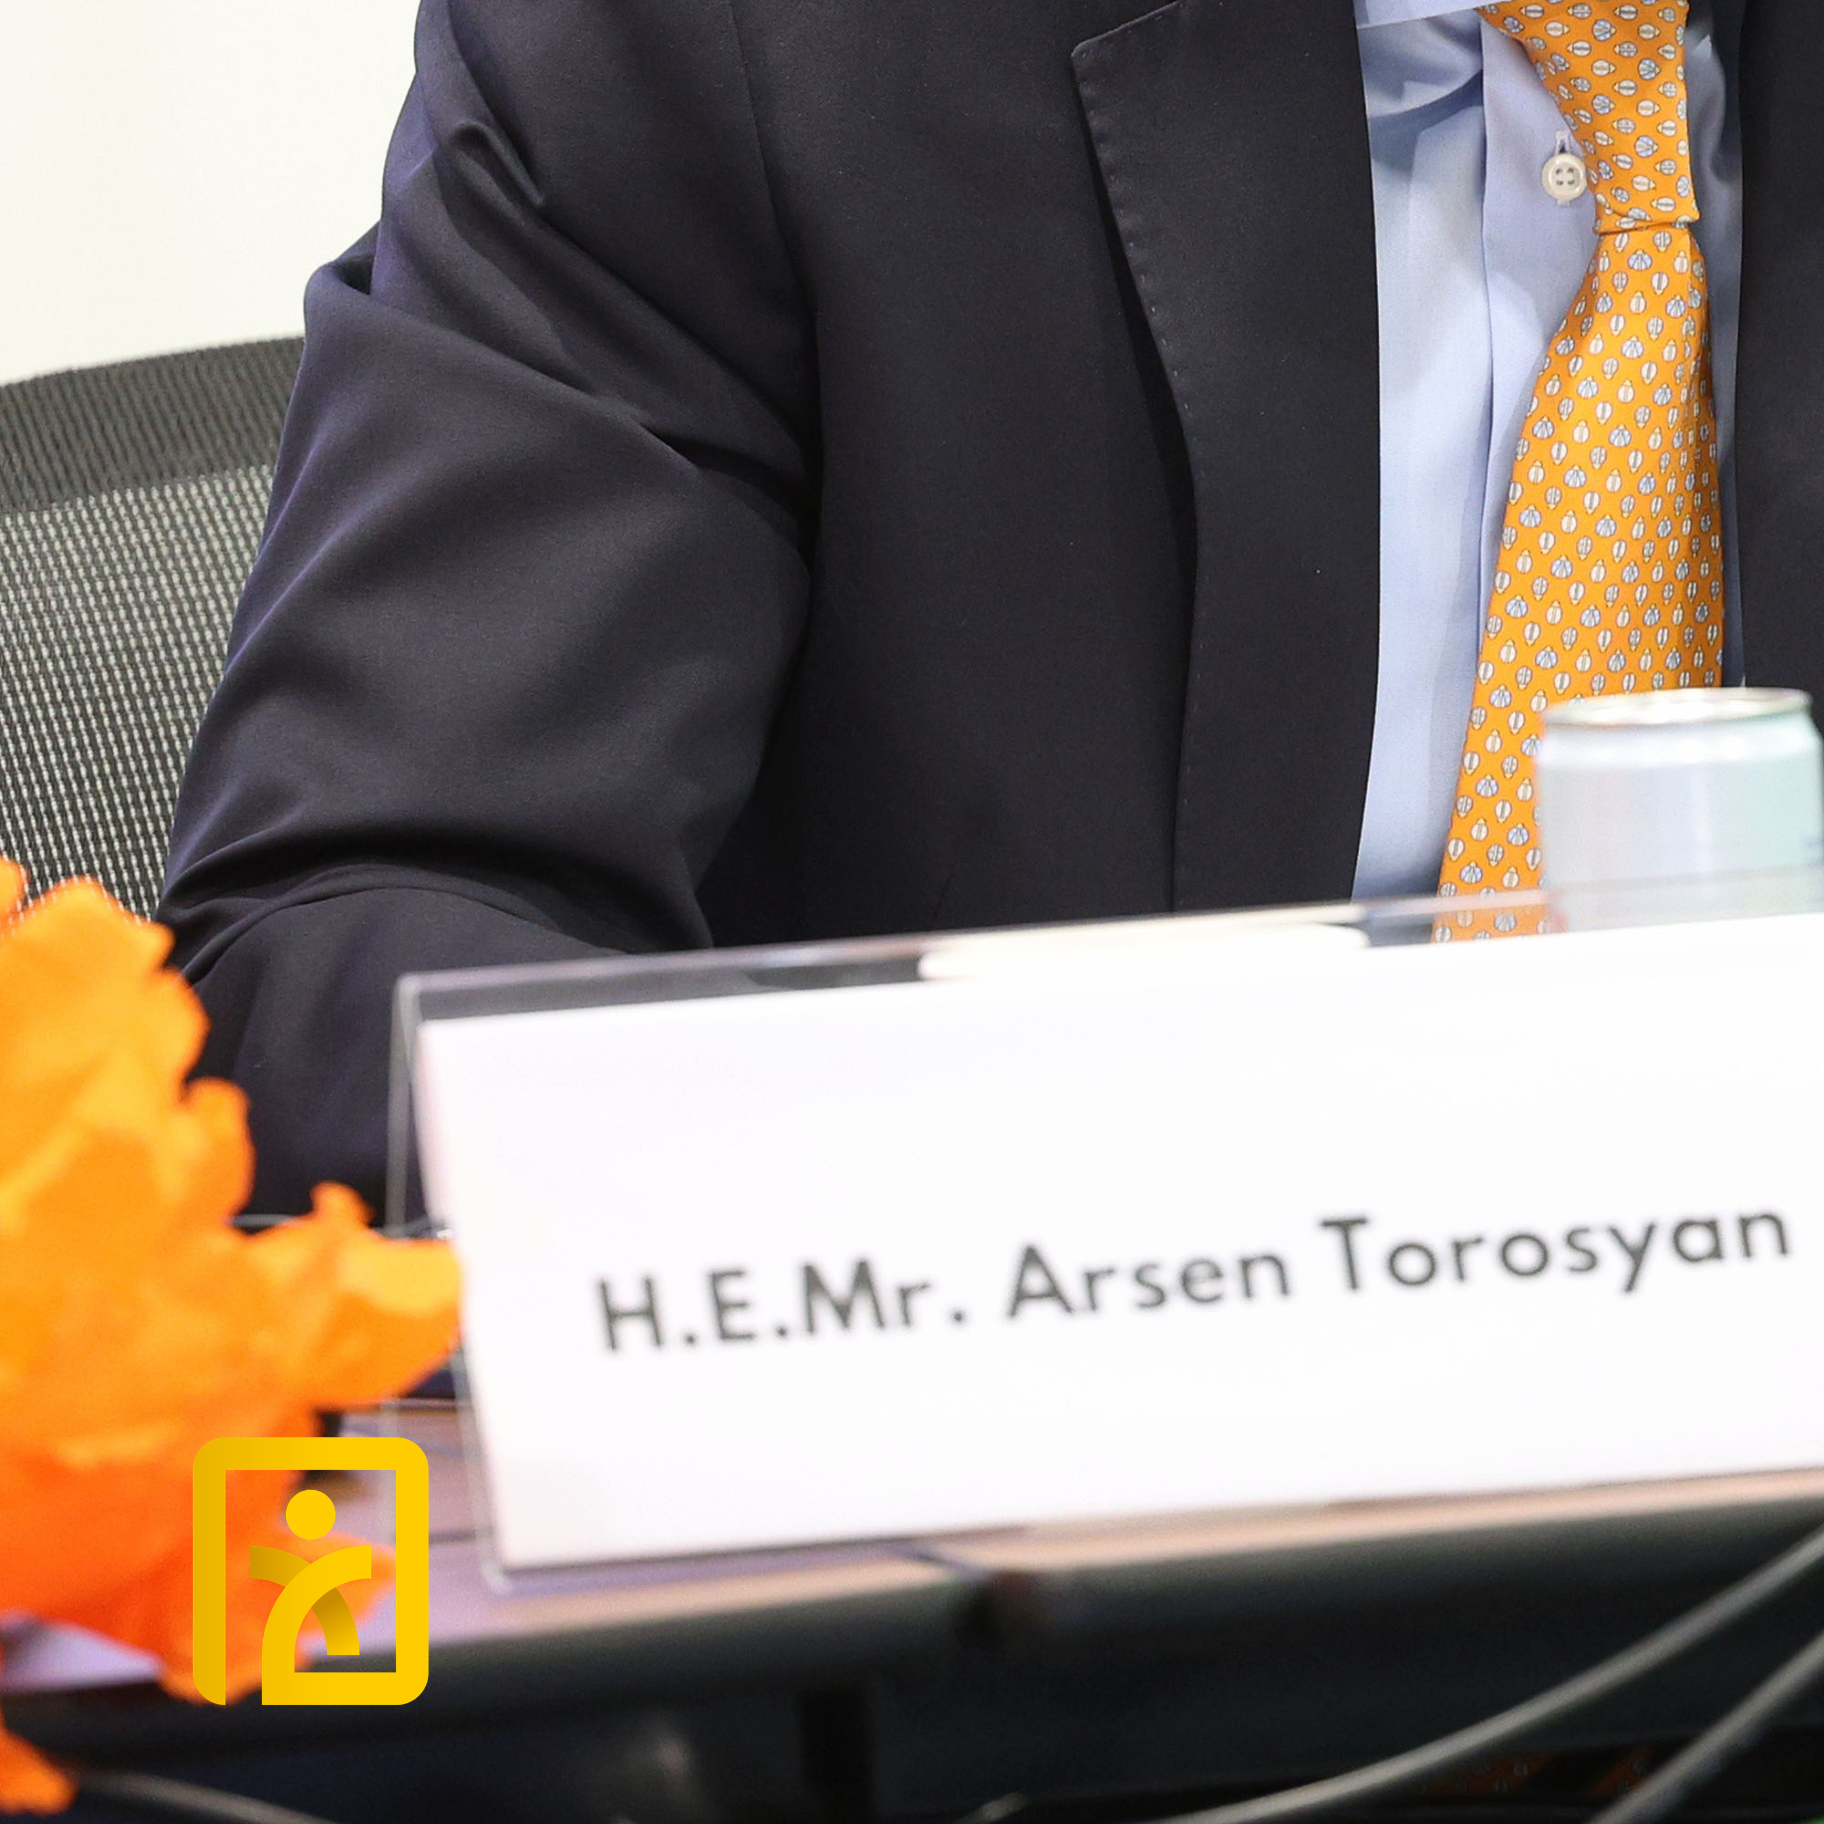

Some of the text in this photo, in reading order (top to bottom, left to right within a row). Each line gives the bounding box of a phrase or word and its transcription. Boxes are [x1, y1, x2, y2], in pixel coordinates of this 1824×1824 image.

[596, 1210, 1791, 1353] H.E.Mr. Arsen Torosyan
